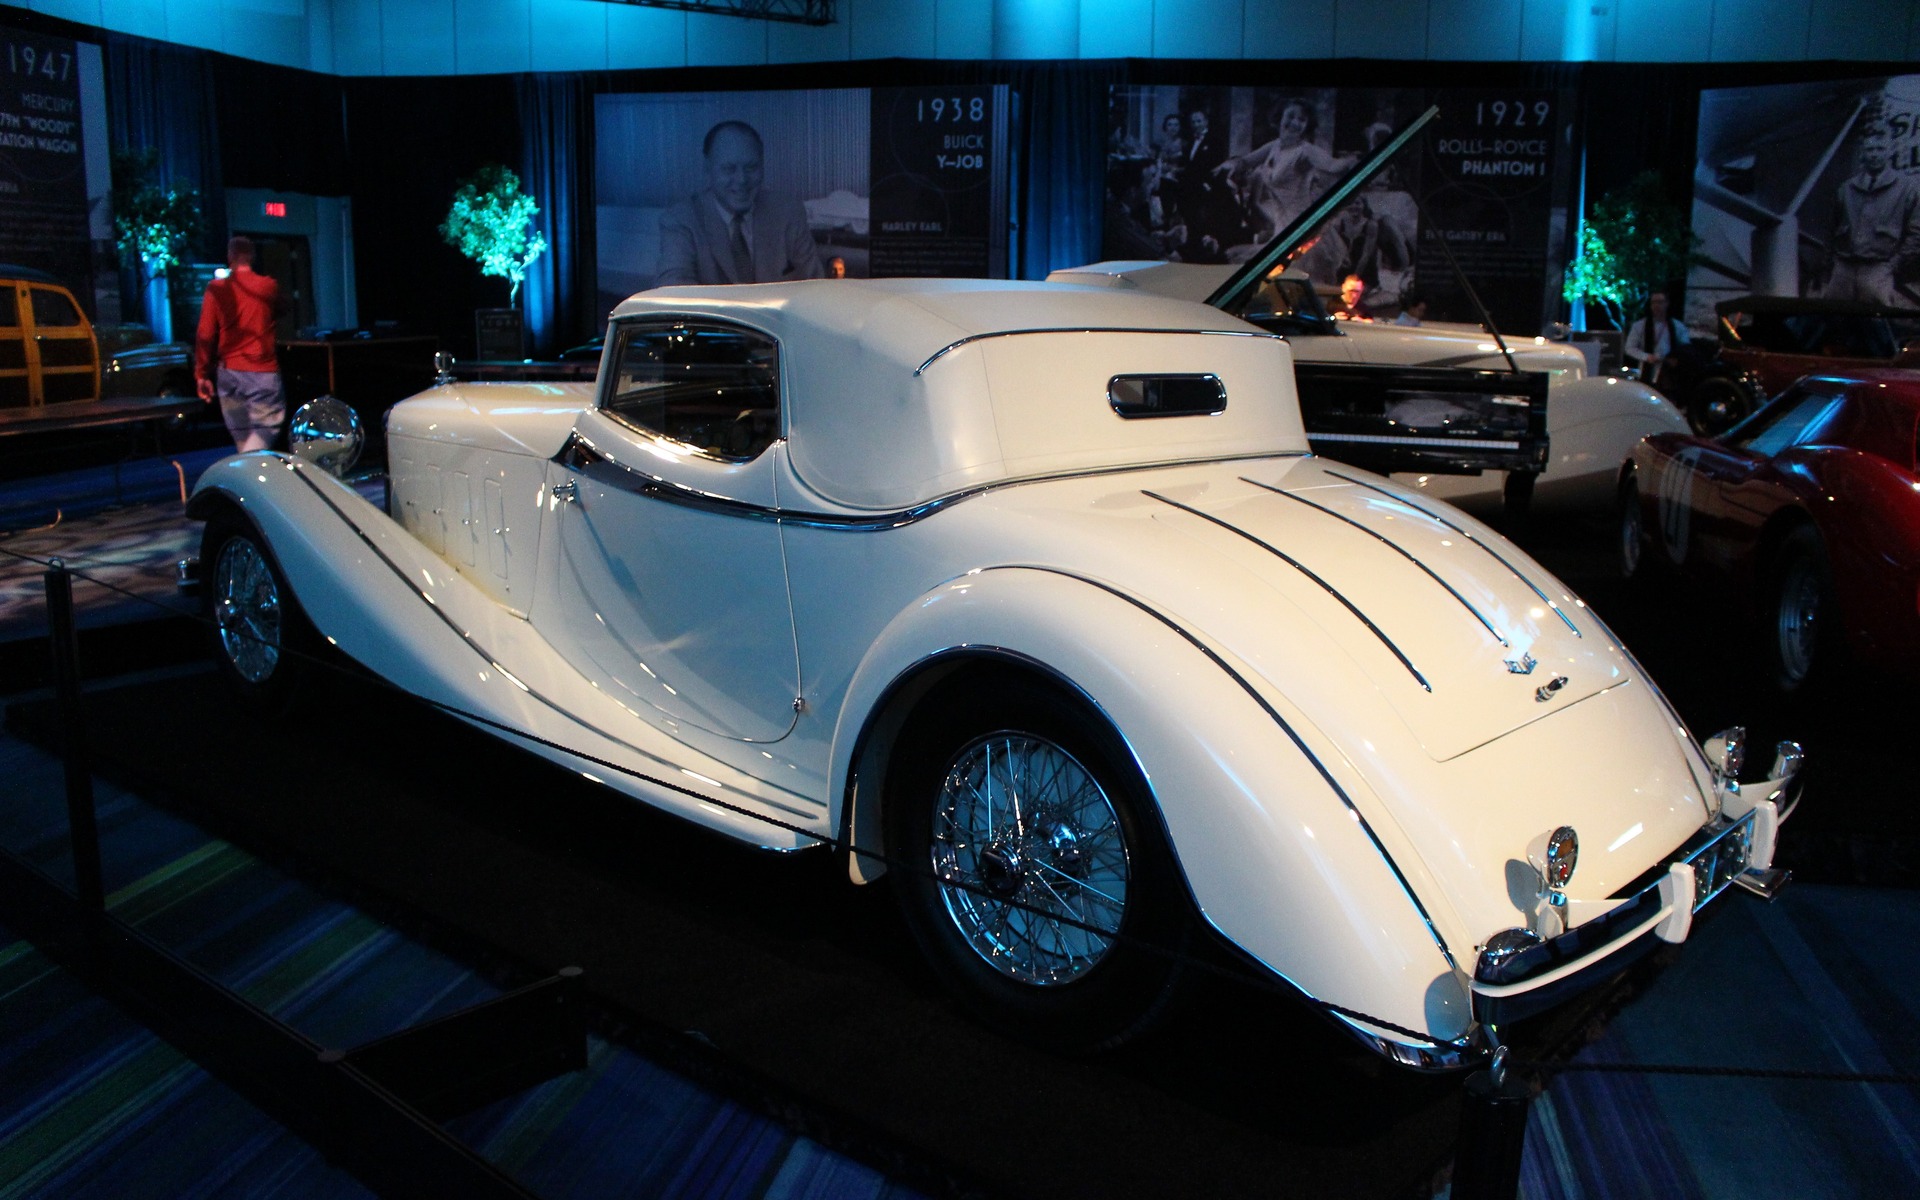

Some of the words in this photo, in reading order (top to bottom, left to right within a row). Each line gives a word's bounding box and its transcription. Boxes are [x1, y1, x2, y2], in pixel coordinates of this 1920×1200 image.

[9, 42, 72, 81] 1947
[21, 92, 75, 114] MERCURY
[917, 97, 985, 123] 1938
[1476, 101, 1550, 127] 1929
[36, 136, 78, 154] WAGON
[943, 134, 985, 149] BUICK
[1461, 160, 1535, 176] PHANTOM
[881, 221, 918, 232] HARLEY
[919, 222, 943, 232] EARL
